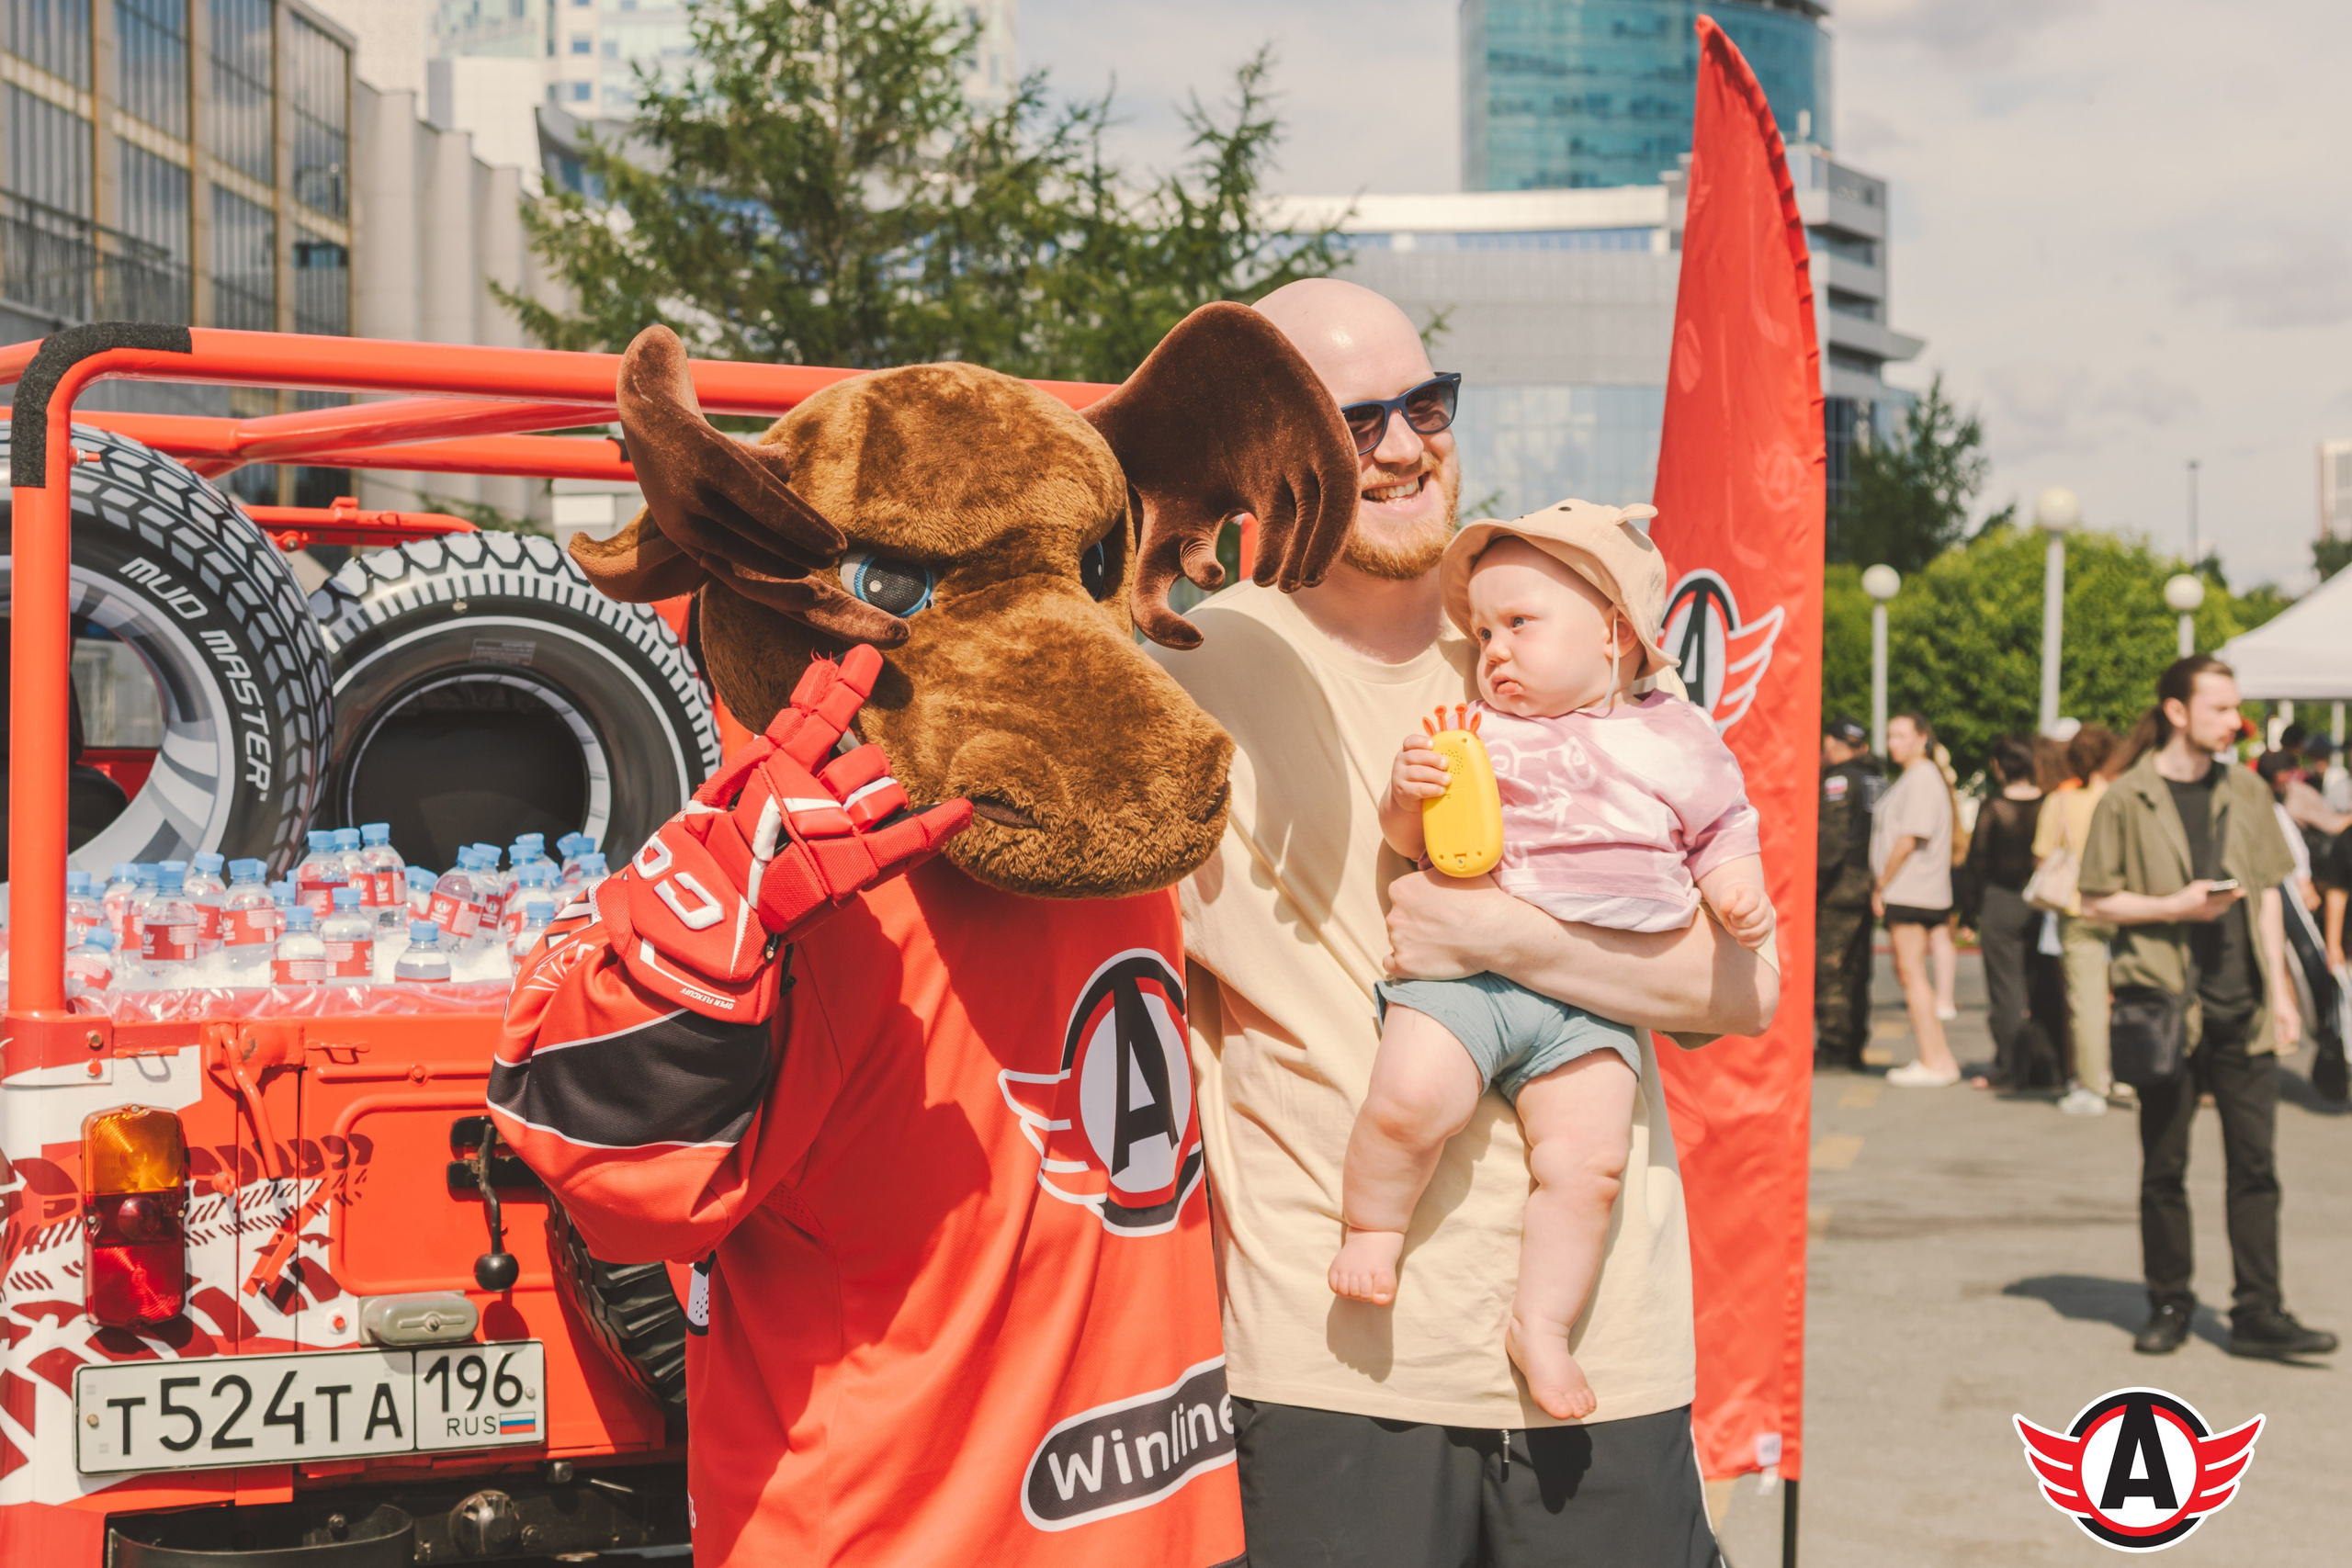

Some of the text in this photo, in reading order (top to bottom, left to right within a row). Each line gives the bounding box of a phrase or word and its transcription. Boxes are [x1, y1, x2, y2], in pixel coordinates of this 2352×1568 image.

[119, 557, 272, 793] MUD MASTER
[680, 987, 734, 1010] OPEN FLEXCUFF
[1111, 957, 1180, 1178] A
[424, 1352, 523, 1413] 196
[447, 1416, 496, 1438] RUS
